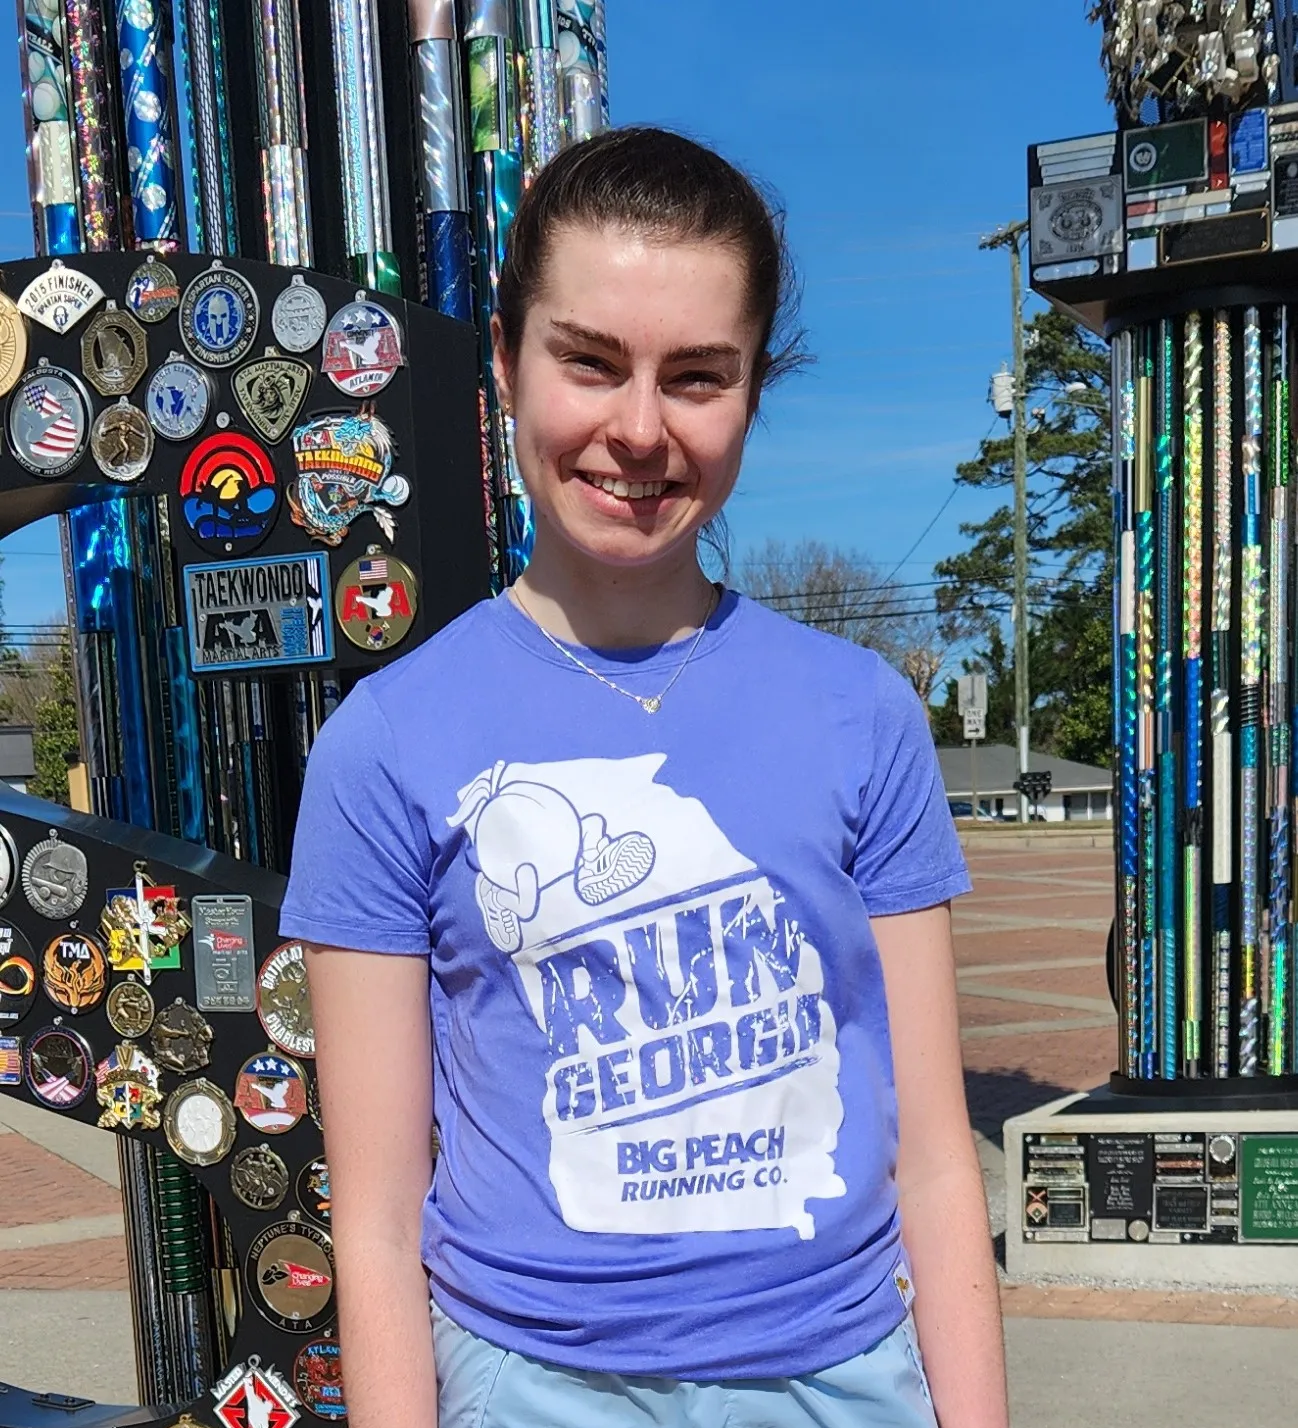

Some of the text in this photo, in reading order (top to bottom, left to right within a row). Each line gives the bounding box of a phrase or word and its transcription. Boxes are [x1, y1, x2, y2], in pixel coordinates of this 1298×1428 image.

[25, 275, 94, 309] 2015 FINISHER
[187, 274, 250, 302] SPARTAN SUPER
[37, 295, 62, 315] SPARTAN
[193, 340, 248, 363] FINISHER 2015
[22, 368, 64, 383] VALDOSTA
[287, 364, 305, 377] ARTS
[195, 562, 305, 609] TAEKWONDO
[202, 646, 281, 664] MARTIAL ARTS
[967, 709, 982, 718] ONE
[60, 942, 91, 959] TMA
[535, 892, 801, 1056] RUN
[265, 1012, 316, 1052] CHARLEST
[553, 993, 822, 1121] GEORGIA
[616, 1126, 785, 1174] BIG PEACH
[620, 1164, 788, 1202] RUNNING CO.
[250, 1223, 336, 1262] NEPTUNE'S TYPHOO
[291, 1271, 324, 1283] Changing
[307, 1345, 341, 1355] ATLAN
